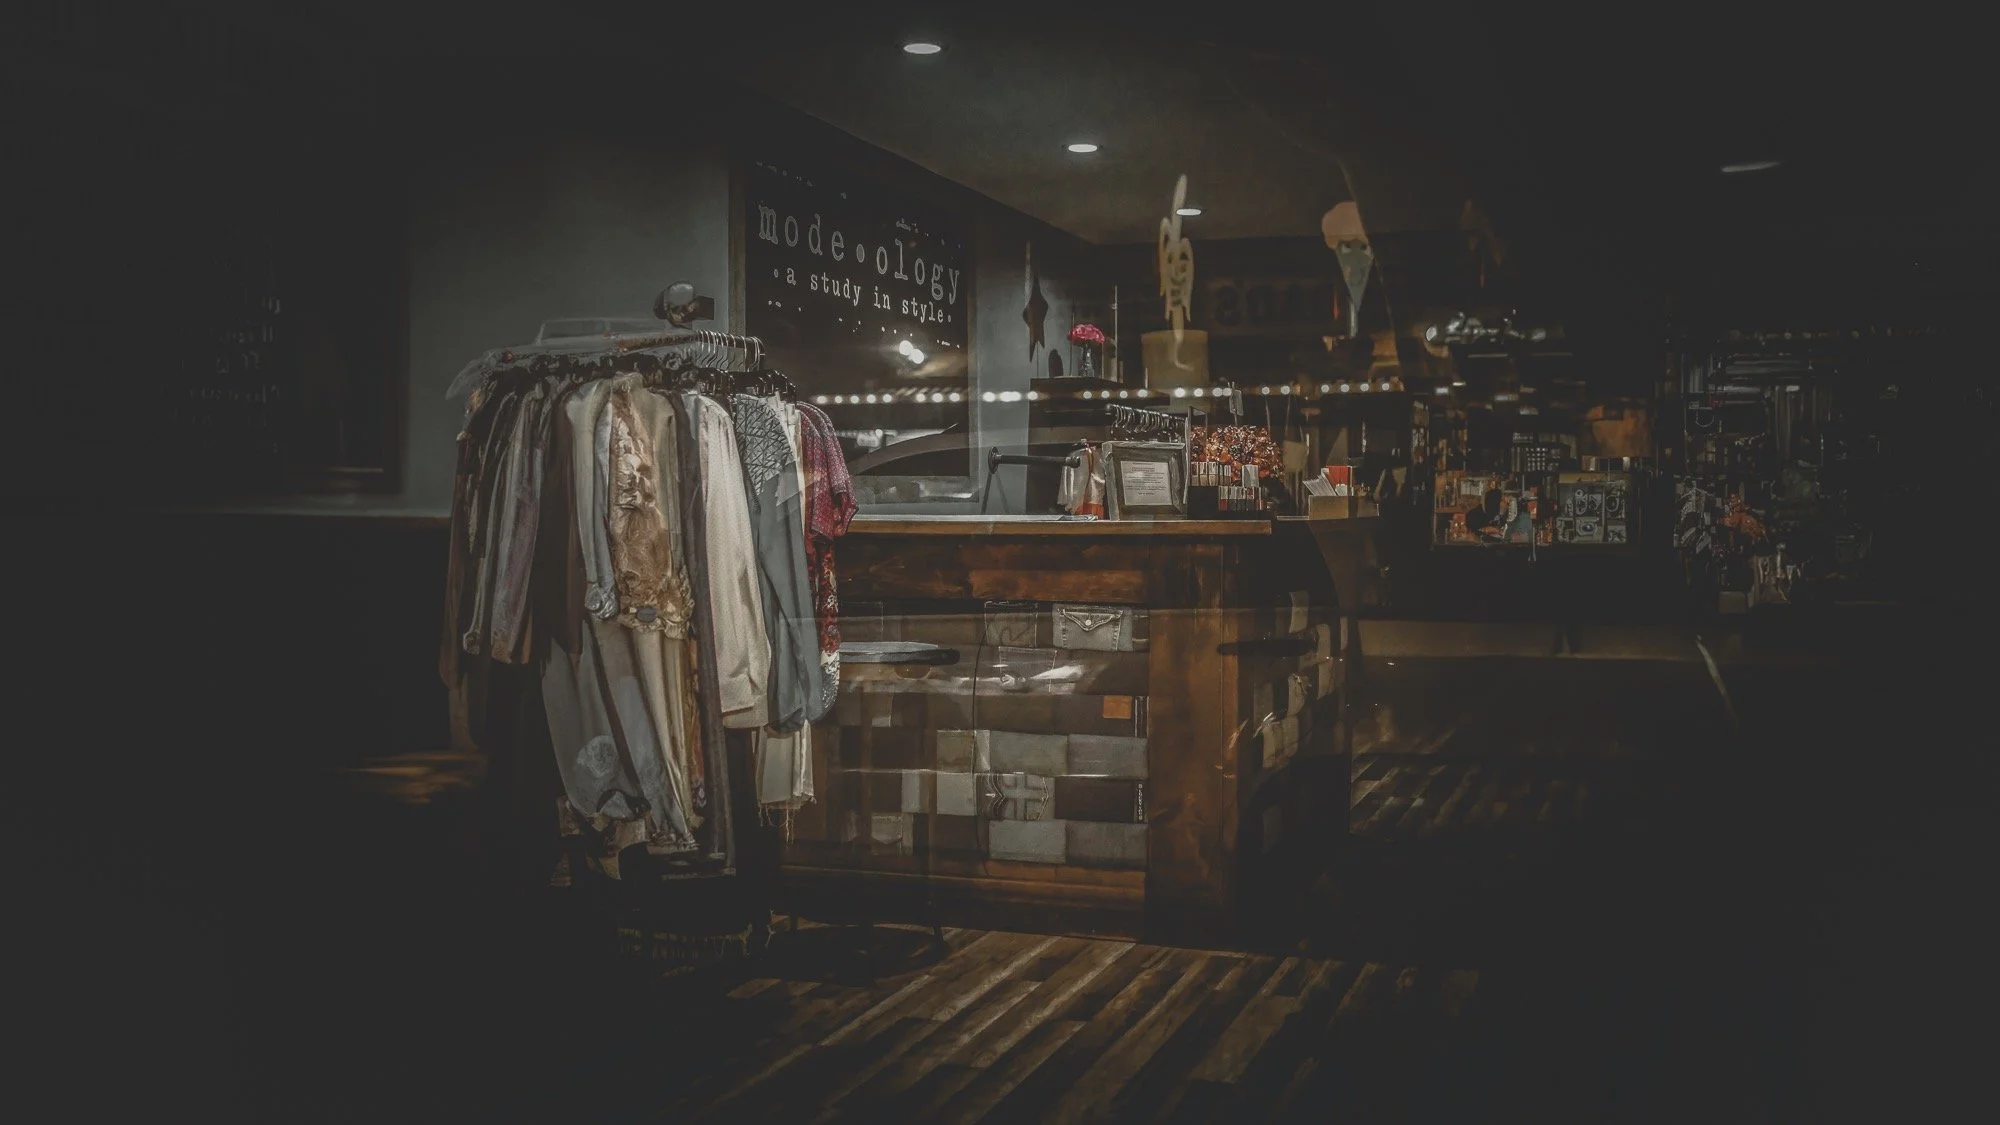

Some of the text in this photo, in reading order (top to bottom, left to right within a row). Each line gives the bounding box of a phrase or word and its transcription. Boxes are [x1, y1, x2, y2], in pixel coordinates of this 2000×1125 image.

[785, 267, 797, 286] a
[810, 271, 862, 307] study
[873, 285, 892, 311] in
